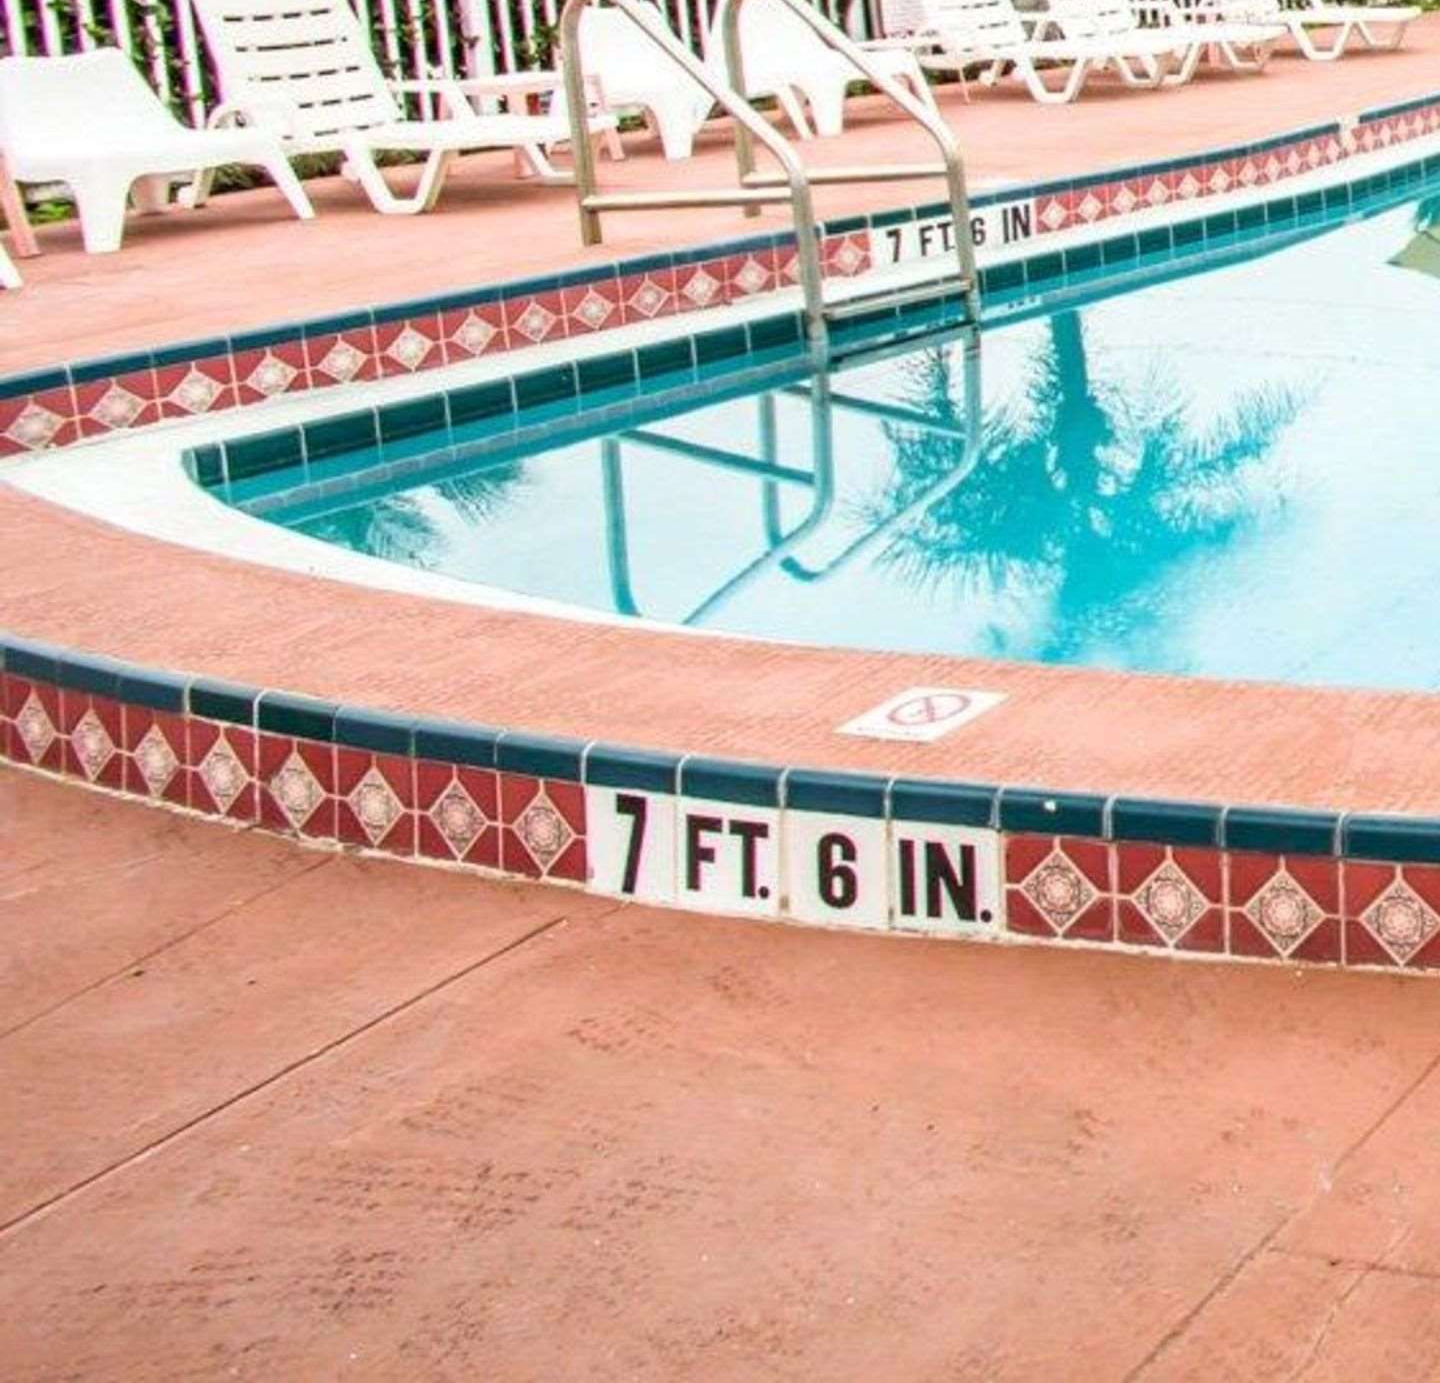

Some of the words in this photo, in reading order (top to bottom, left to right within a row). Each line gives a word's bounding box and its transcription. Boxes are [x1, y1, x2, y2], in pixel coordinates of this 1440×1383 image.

[886, 228, 902, 263] 7
[970, 217, 987, 247] 6
[616, 793, 647, 894] 7
[686, 814, 770, 899] FT.
[816, 832, 859, 909] 6
[898, 839, 993, 922] IN.
